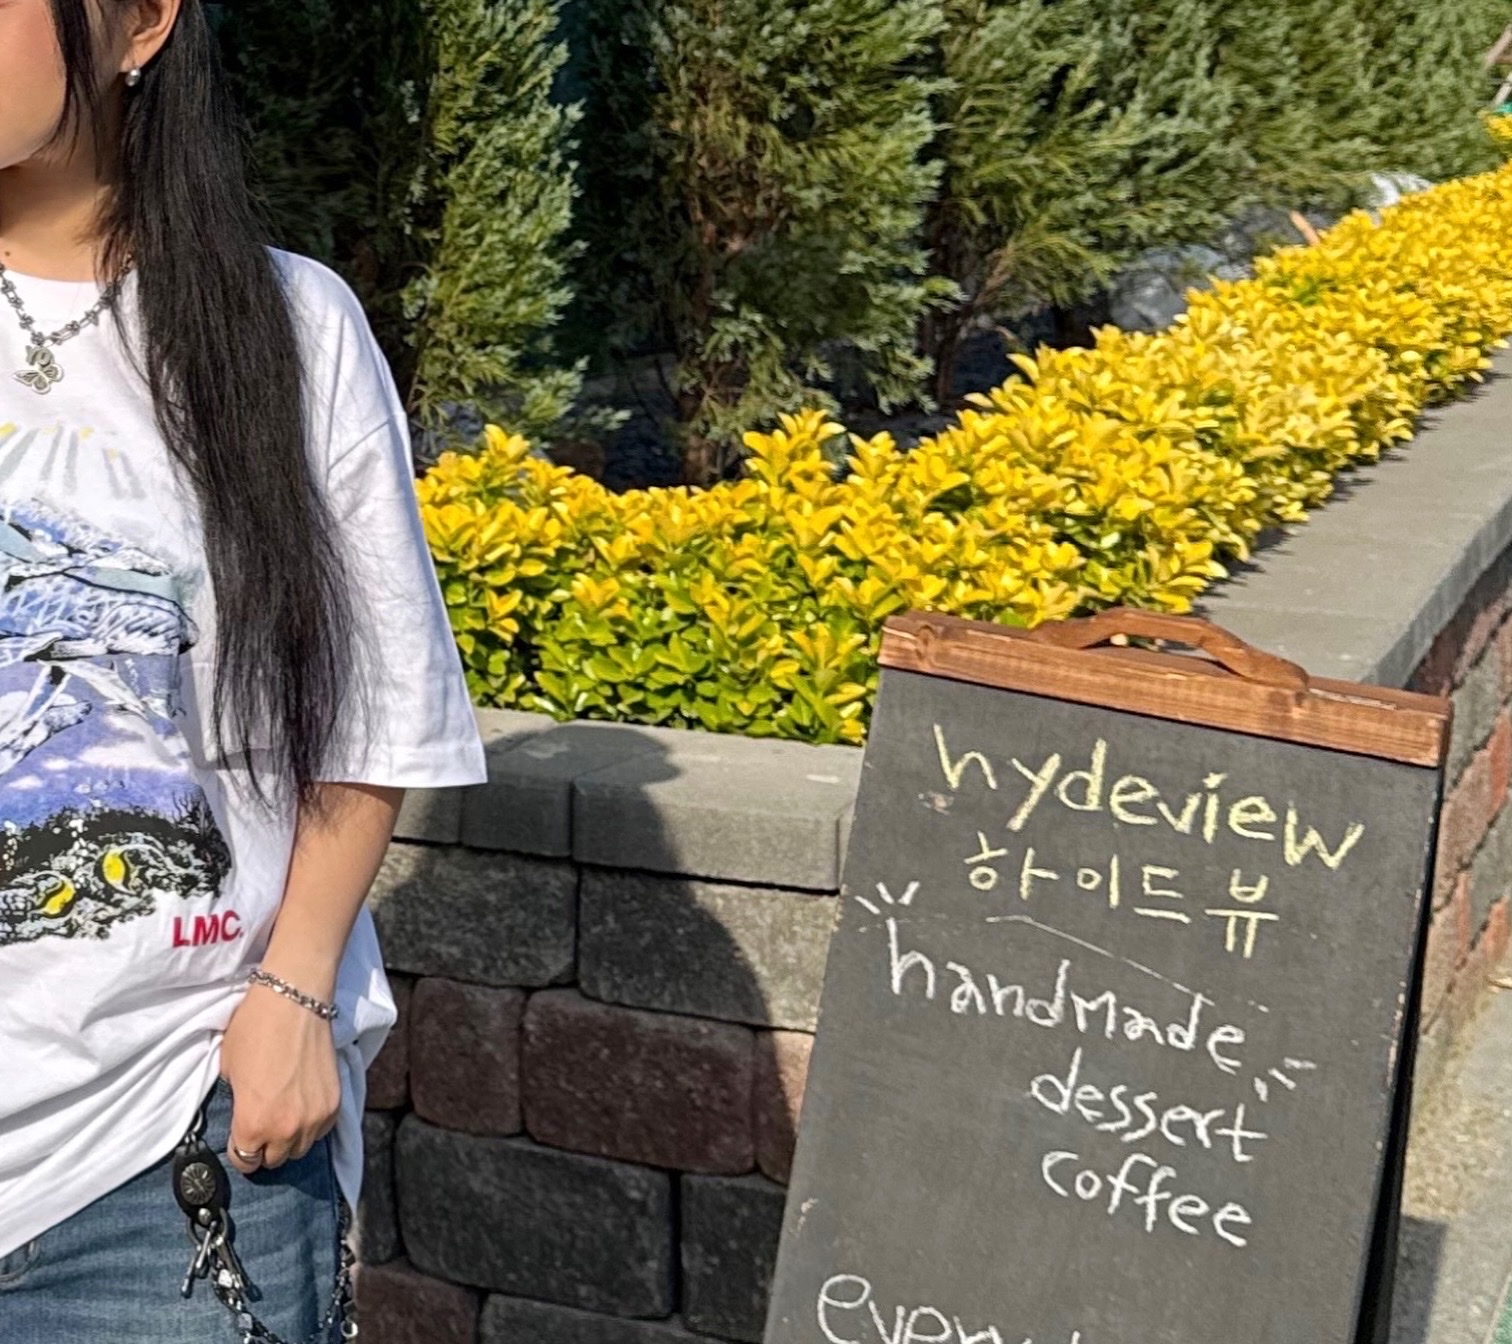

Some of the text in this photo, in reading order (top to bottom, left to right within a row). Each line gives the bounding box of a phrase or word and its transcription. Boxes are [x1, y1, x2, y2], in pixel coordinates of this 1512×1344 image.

[933, 724, 1365, 869] hydeview
[1030, 1047, 1268, 1162] dessert
[1042, 1150, 1253, 1247] coffee
